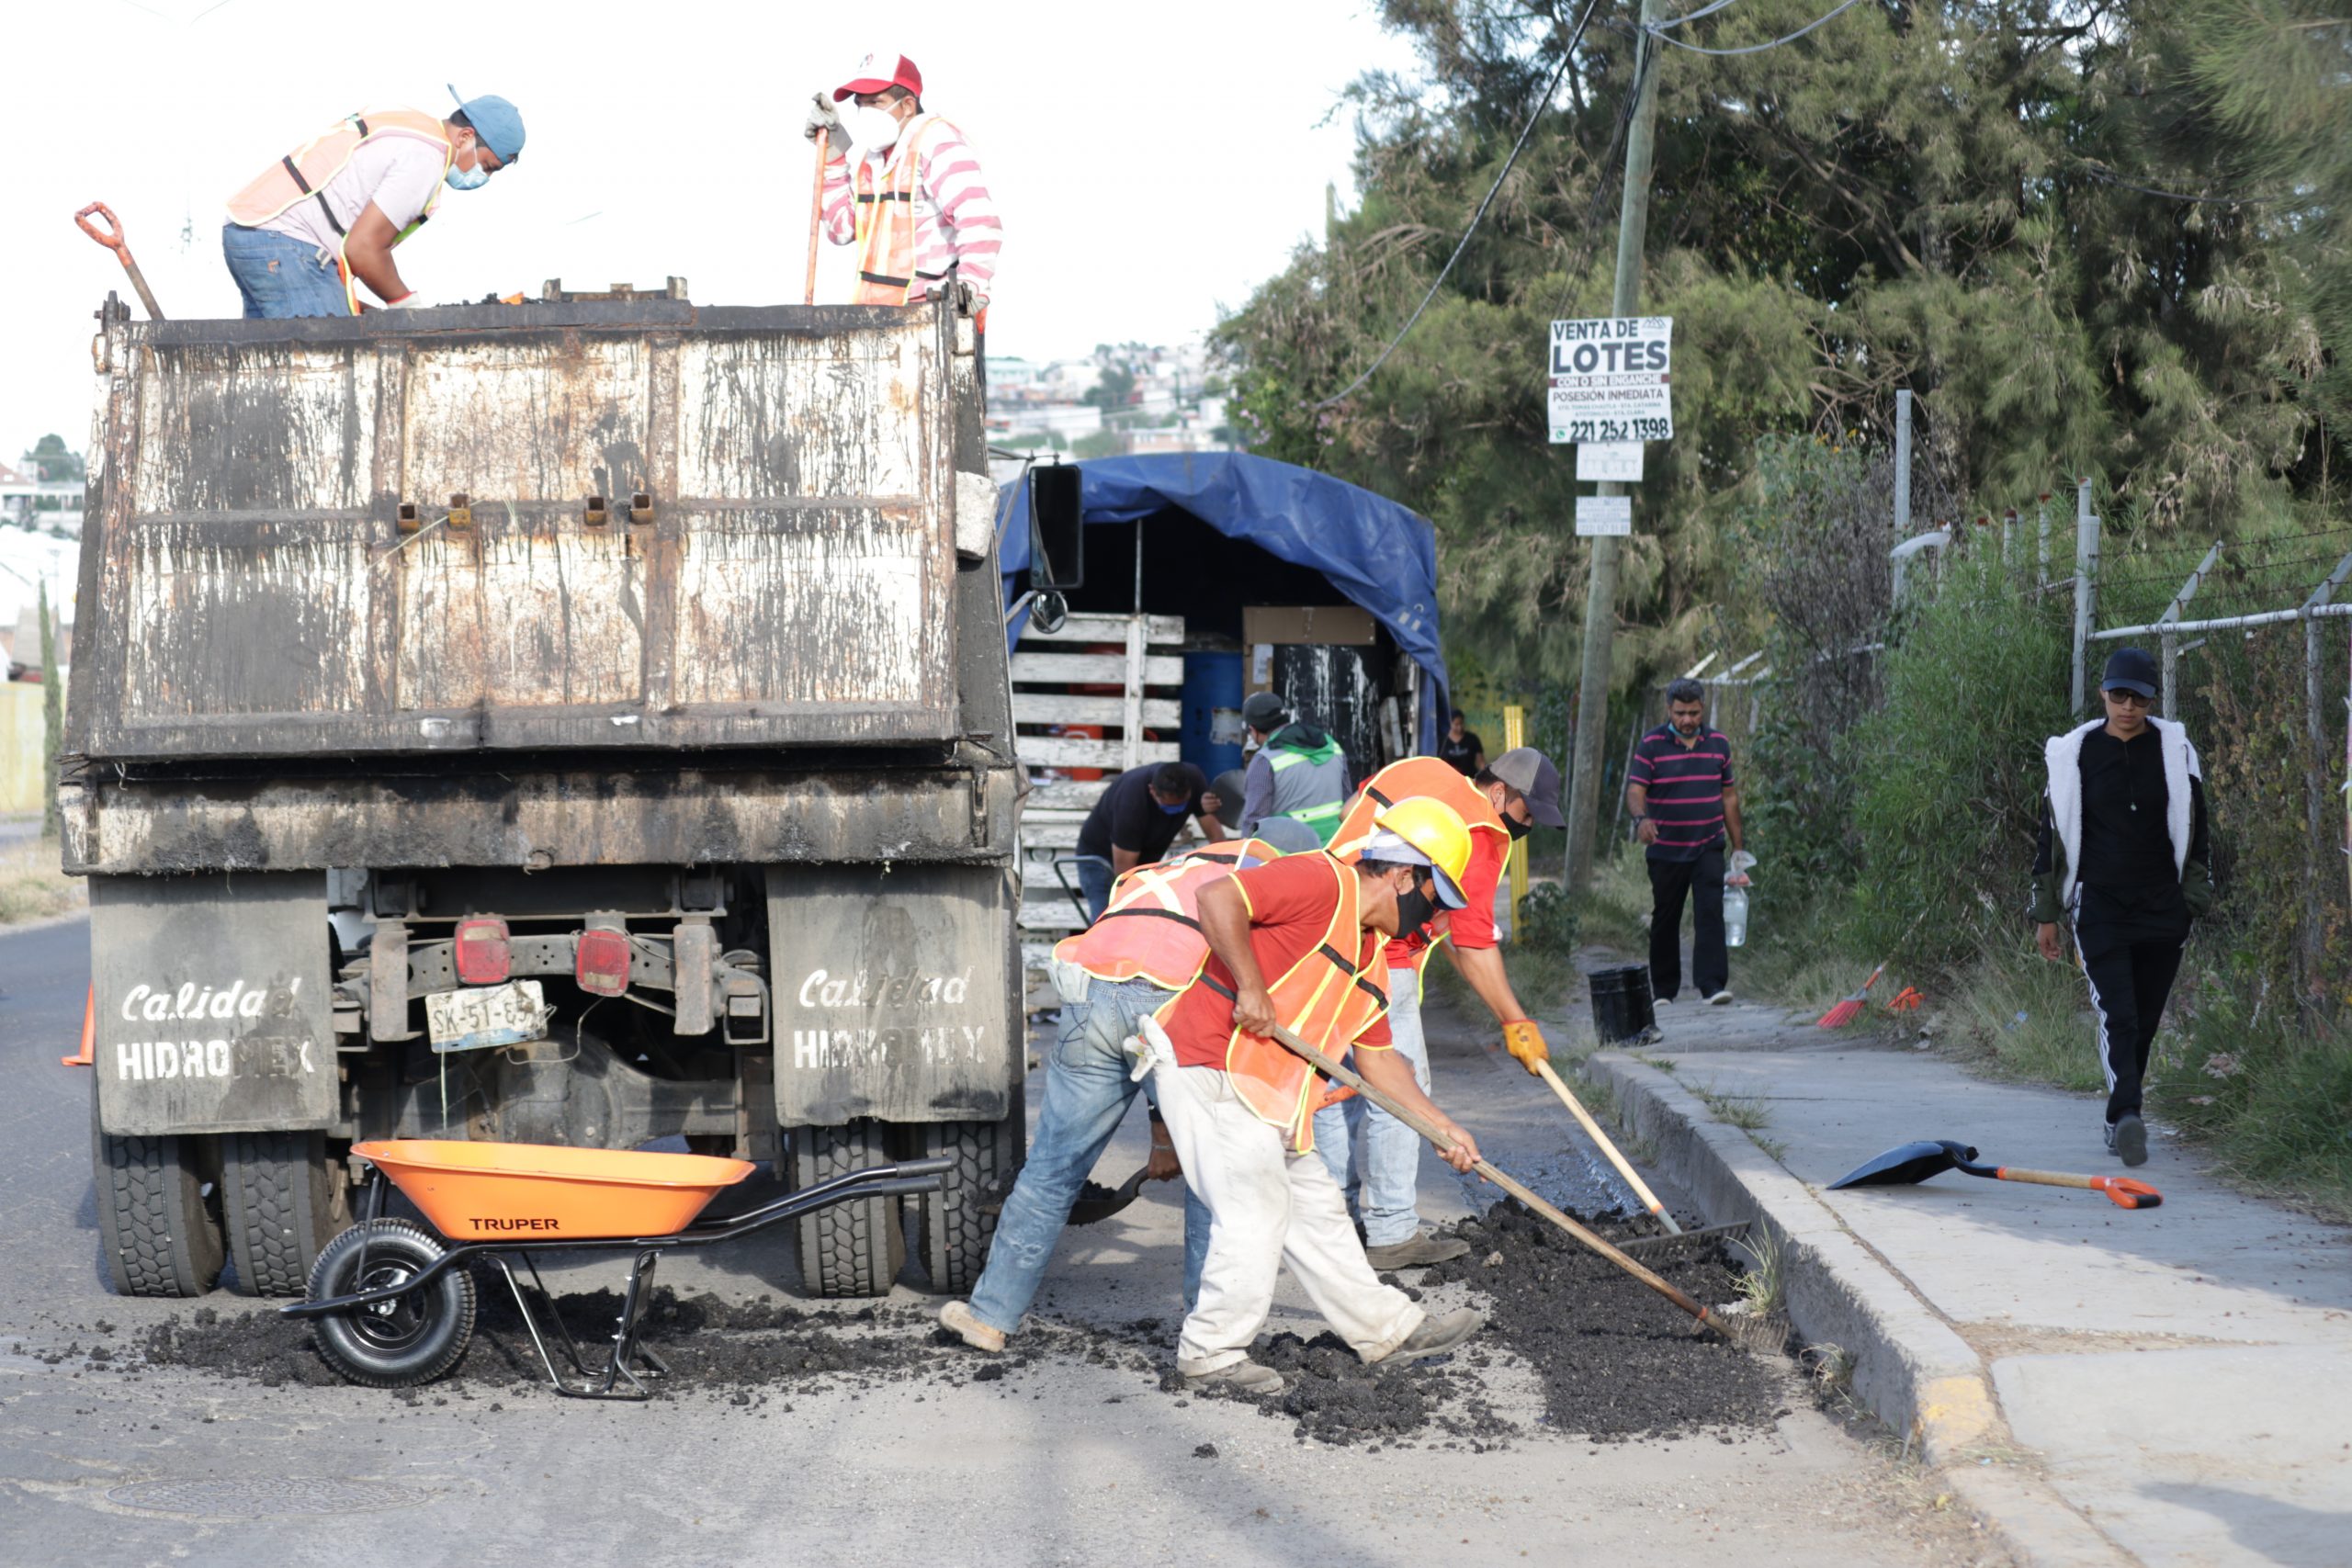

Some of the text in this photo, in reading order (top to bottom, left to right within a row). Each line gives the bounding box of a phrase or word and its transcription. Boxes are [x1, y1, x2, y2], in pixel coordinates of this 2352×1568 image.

[1554, 319, 1638, 341] VENTA DE
[1553, 340, 1668, 374] LOTES
[1557, 375, 1661, 387] CON O SIN ENGANCHE
[1553, 388, 1664, 402] POSESIÓN INMEDIATA
[1570, 417, 1669, 442] 221 252 1398
[120, 976, 302, 1021] Calidad
[469, 1218, 560, 1231] TRUPER
